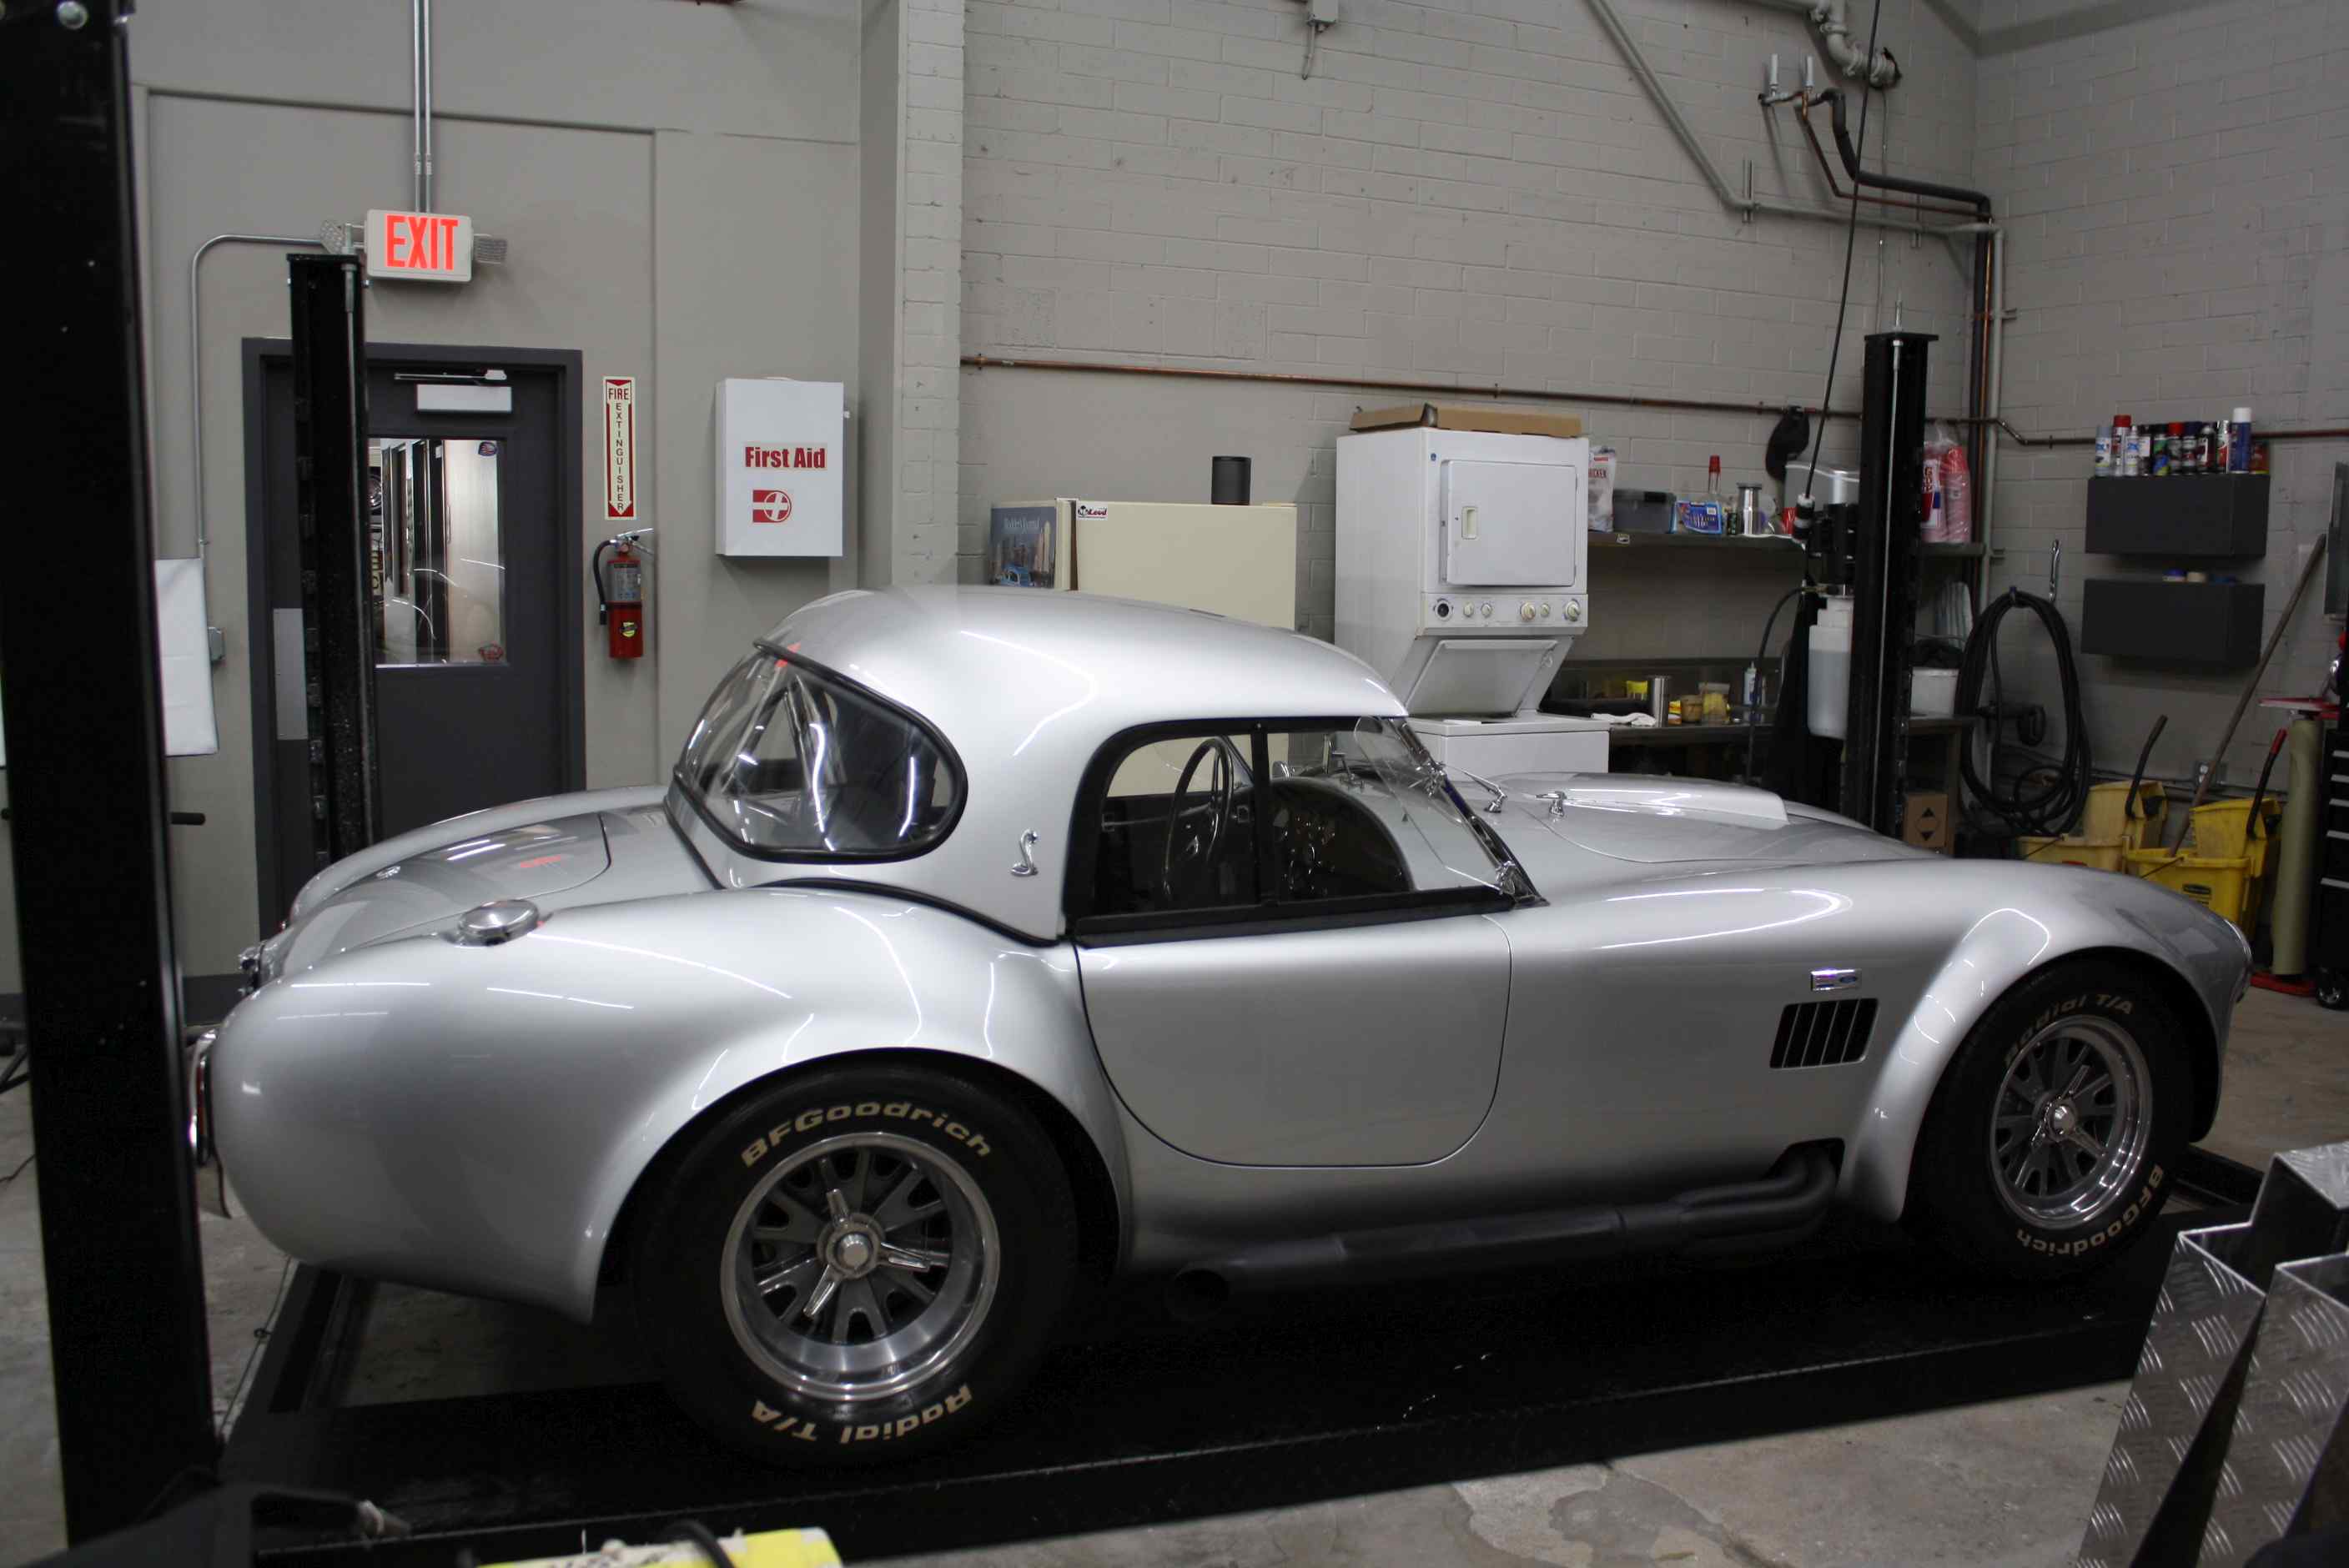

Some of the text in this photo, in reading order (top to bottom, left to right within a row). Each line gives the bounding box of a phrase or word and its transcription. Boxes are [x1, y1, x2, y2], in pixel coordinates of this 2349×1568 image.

[385, 214, 458, 270] EXIT
[608, 388, 629, 400] FIRE
[616, 403, 624, 510] EXTINGUISHER
[745, 446, 827, 469] First Aid
[2095, 993, 2134, 1016] T/A
[740, 1102, 992, 1167] BFGoodrich
[2016, 1164, 2164, 1256] BFGoodrich
[752, 1383, 973, 1444] Radial T/A
